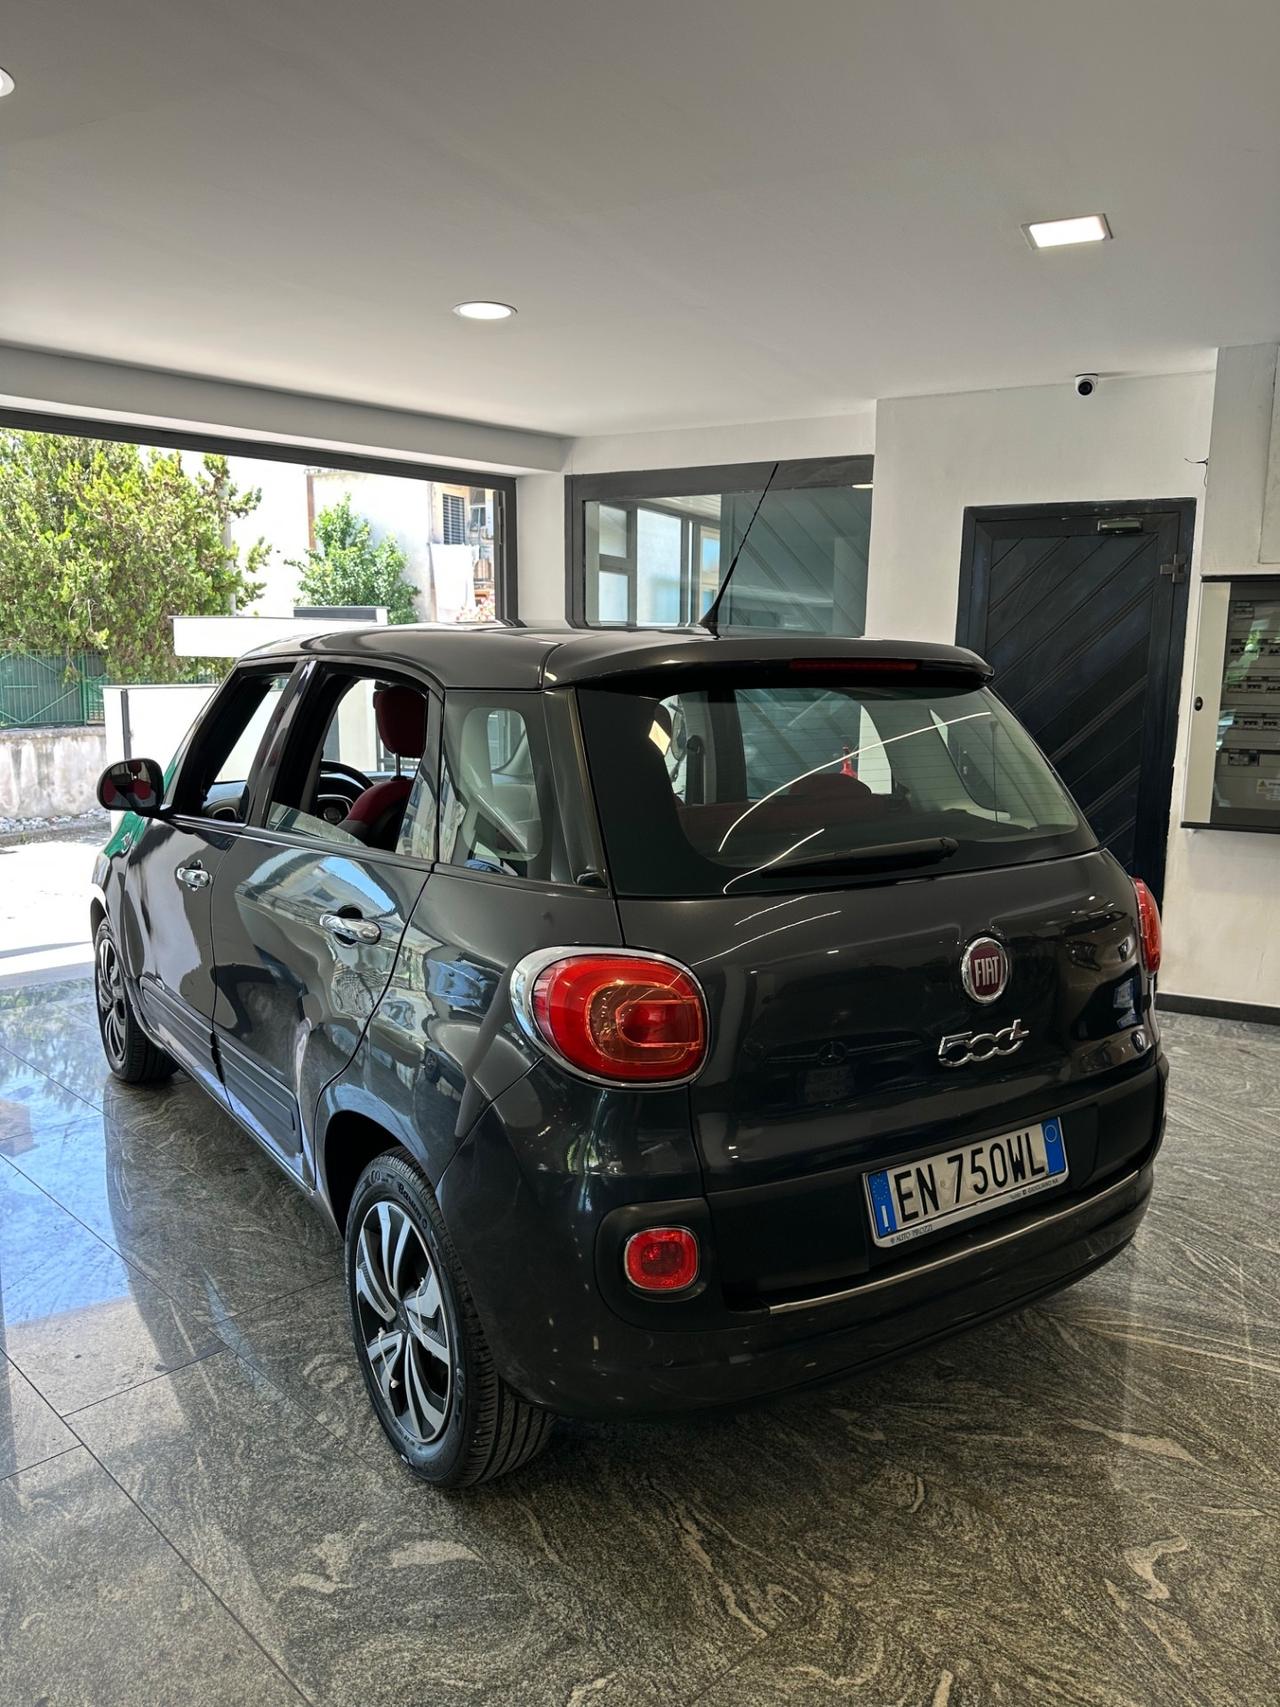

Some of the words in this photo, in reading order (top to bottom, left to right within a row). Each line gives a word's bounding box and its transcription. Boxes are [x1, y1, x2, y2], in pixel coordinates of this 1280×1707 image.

[974, 956, 1000, 987] FIAT
[894, 1163, 940, 1223] EN
[947, 1132, 1045, 1204] 750WL
